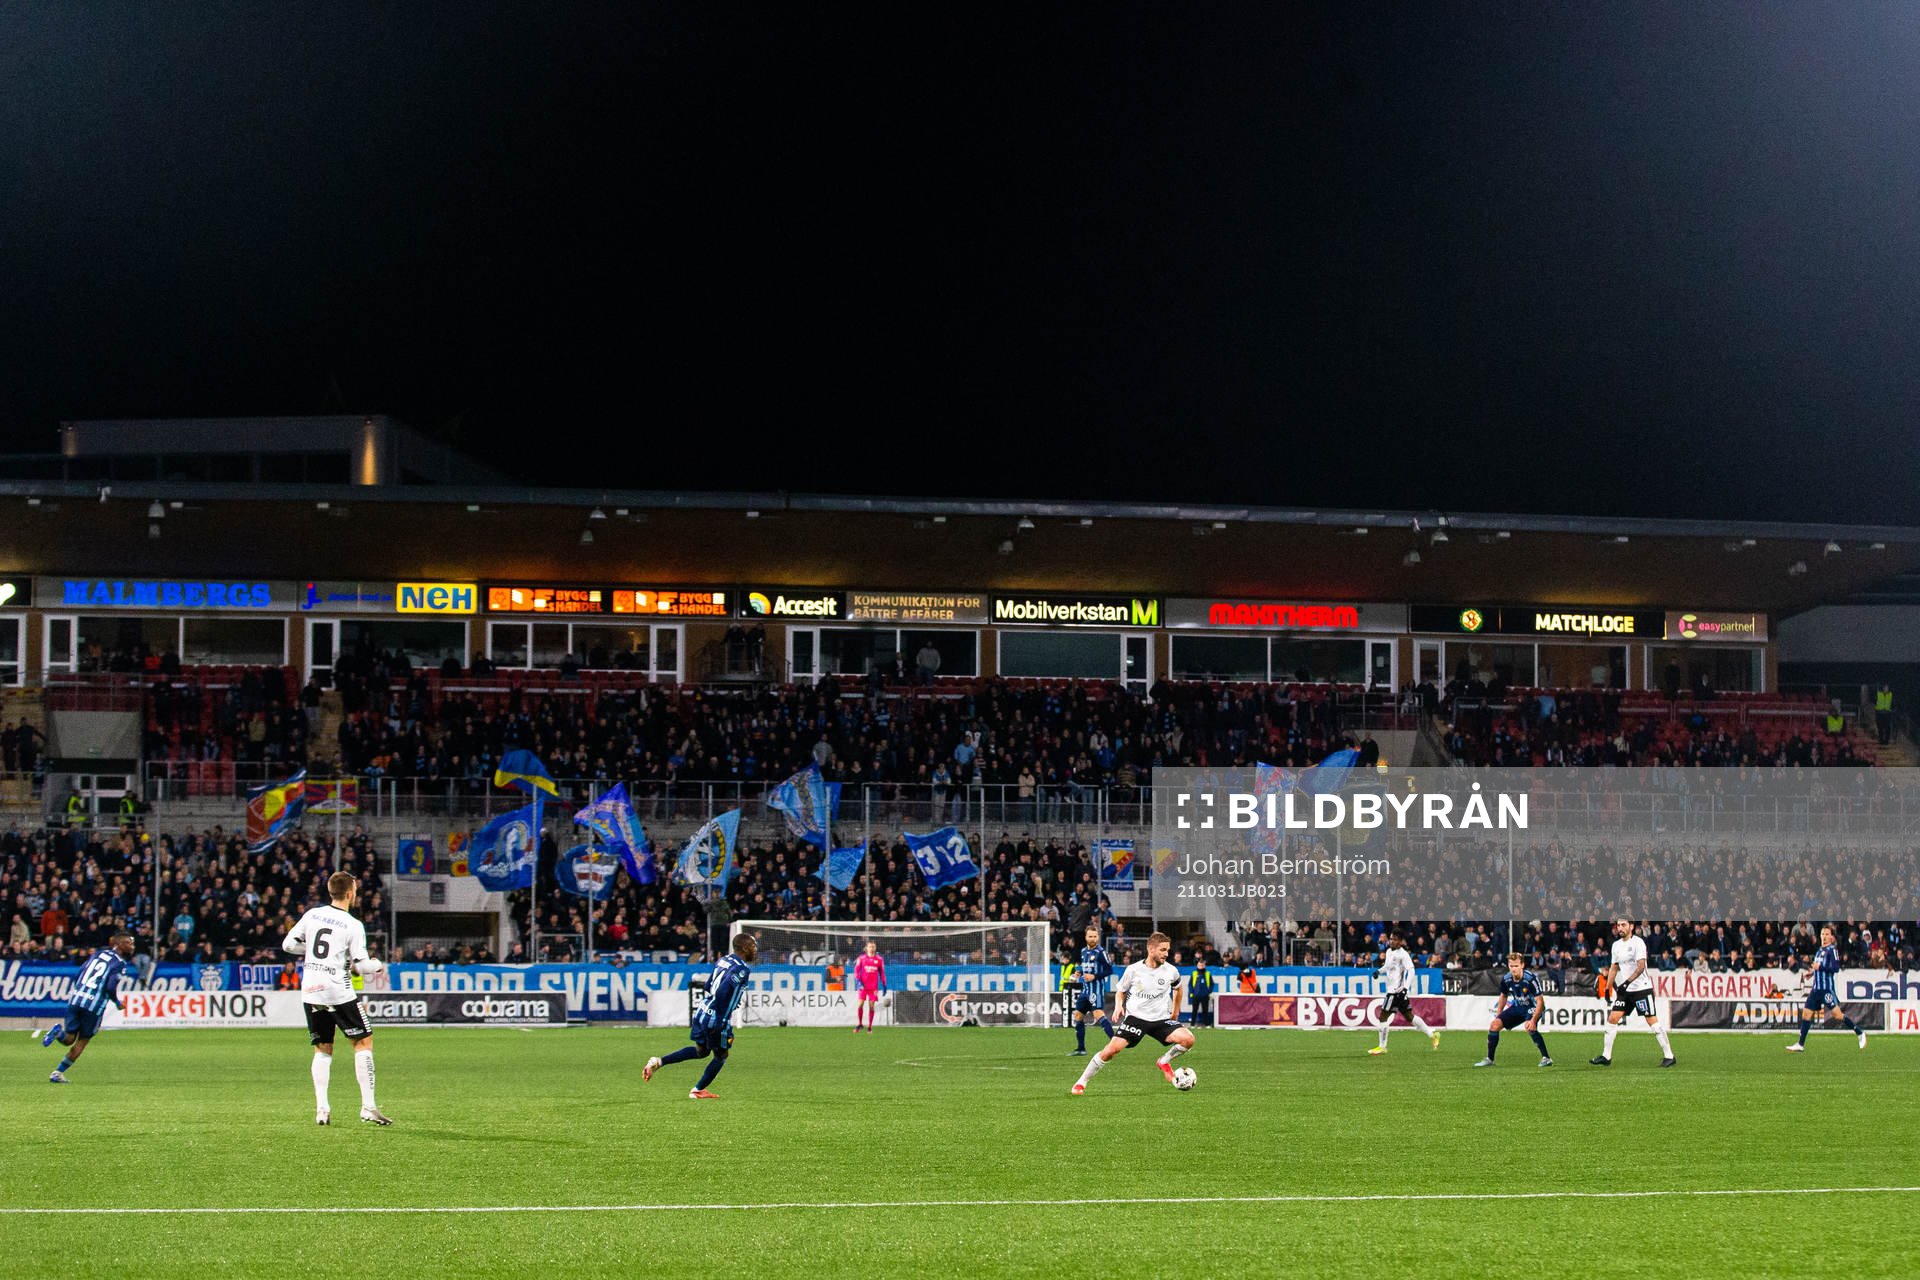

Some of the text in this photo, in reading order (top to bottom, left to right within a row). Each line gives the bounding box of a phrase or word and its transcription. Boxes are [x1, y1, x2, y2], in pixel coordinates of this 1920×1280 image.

[63, 581, 271, 607] MALMBERGS
[854, 595, 955, 607] KOMMUNIKATION
[680, 604, 727, 615] HANDEL
[774, 596, 837, 616] Accesit
[902, 607, 955, 620] AFFÄRER
[996, 600, 1128, 621] Mobilverkstan
[1209, 603, 1358, 628] MAXITHERM
[1535, 613, 1634, 633] MATCHLOGE
[1698, 621, 1754, 633] easypartner
[312, 928, 332, 960] 6
[81, 958, 107, 989] 12
[461, 995, 550, 1018] colorama
[792, 994, 848, 1008] MEDIA
